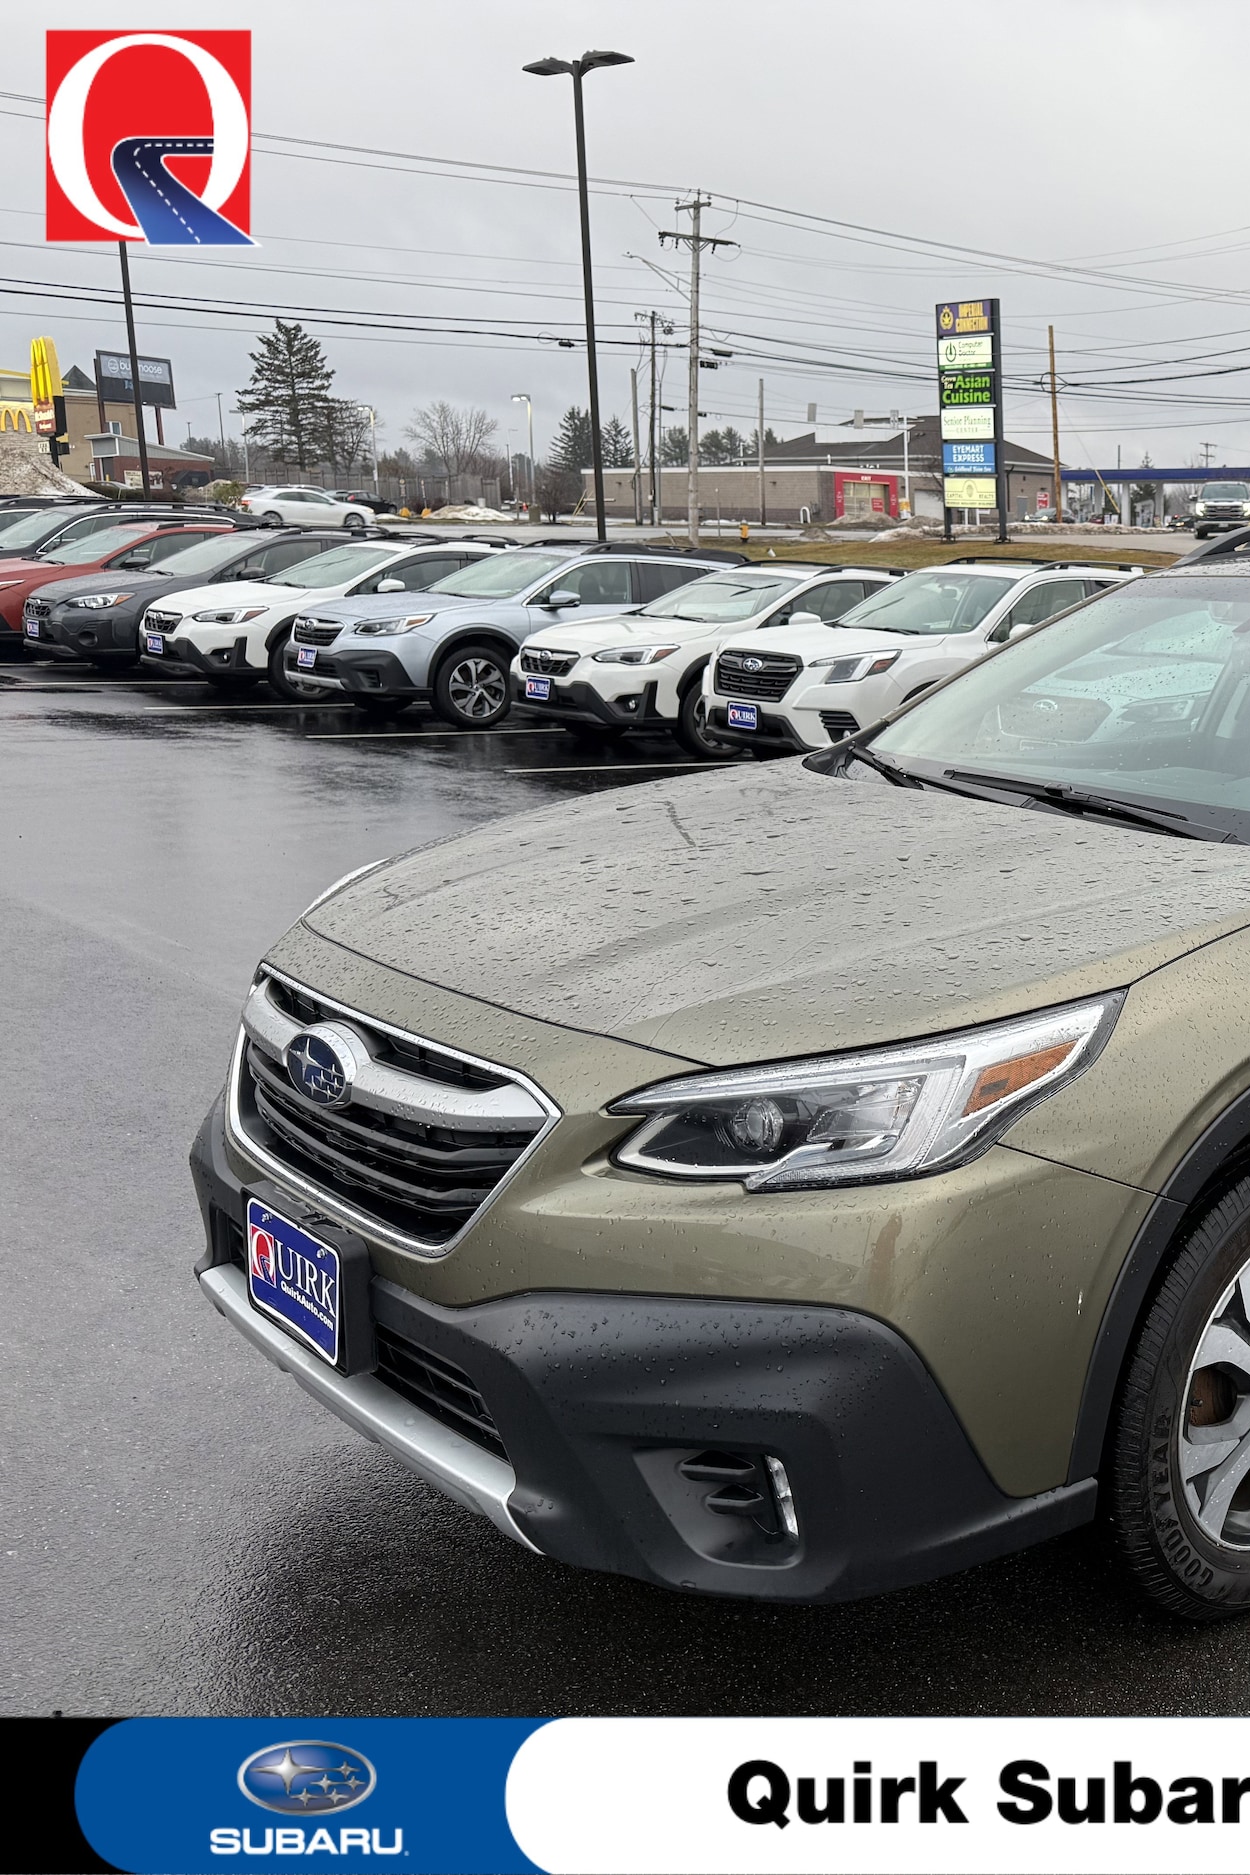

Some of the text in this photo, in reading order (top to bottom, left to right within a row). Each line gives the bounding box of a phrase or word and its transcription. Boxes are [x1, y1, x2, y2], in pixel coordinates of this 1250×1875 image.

[955, 375, 990, 389] Asian
[942, 389, 990, 404] Cuisine
[943, 415, 991, 428] Senior Planning
[952, 444, 984, 454] EYEMART
[953, 454, 985, 463] EXPRESS
[251, 1230, 336, 1319] QUIRK
[280, 1280, 335, 1332] QuirkAuto.com
